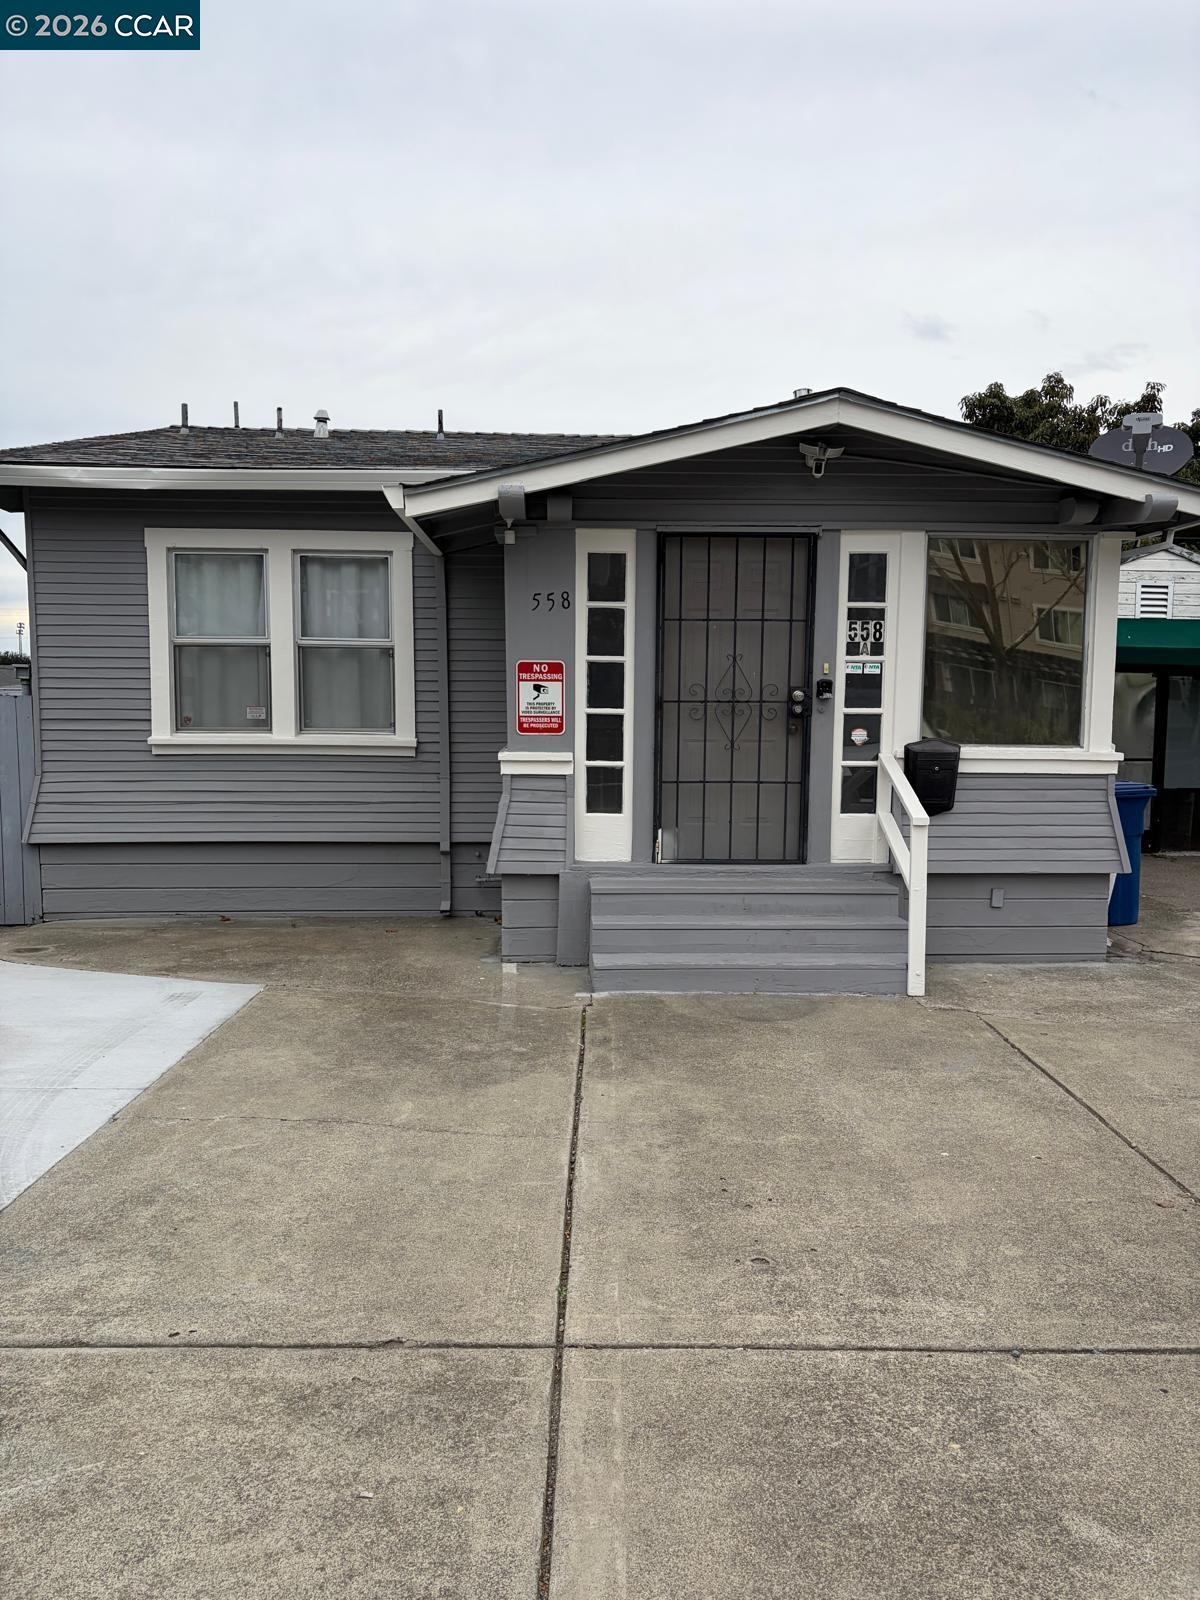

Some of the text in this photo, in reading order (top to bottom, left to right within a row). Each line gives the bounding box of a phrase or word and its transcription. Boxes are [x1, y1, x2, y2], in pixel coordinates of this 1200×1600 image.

[1121, 438, 1174, 453] dh HD
[531, 591, 570, 611] 558
[848, 621, 883, 642] 558
[860, 642, 870, 656] A
[533, 664, 549, 673] NO
